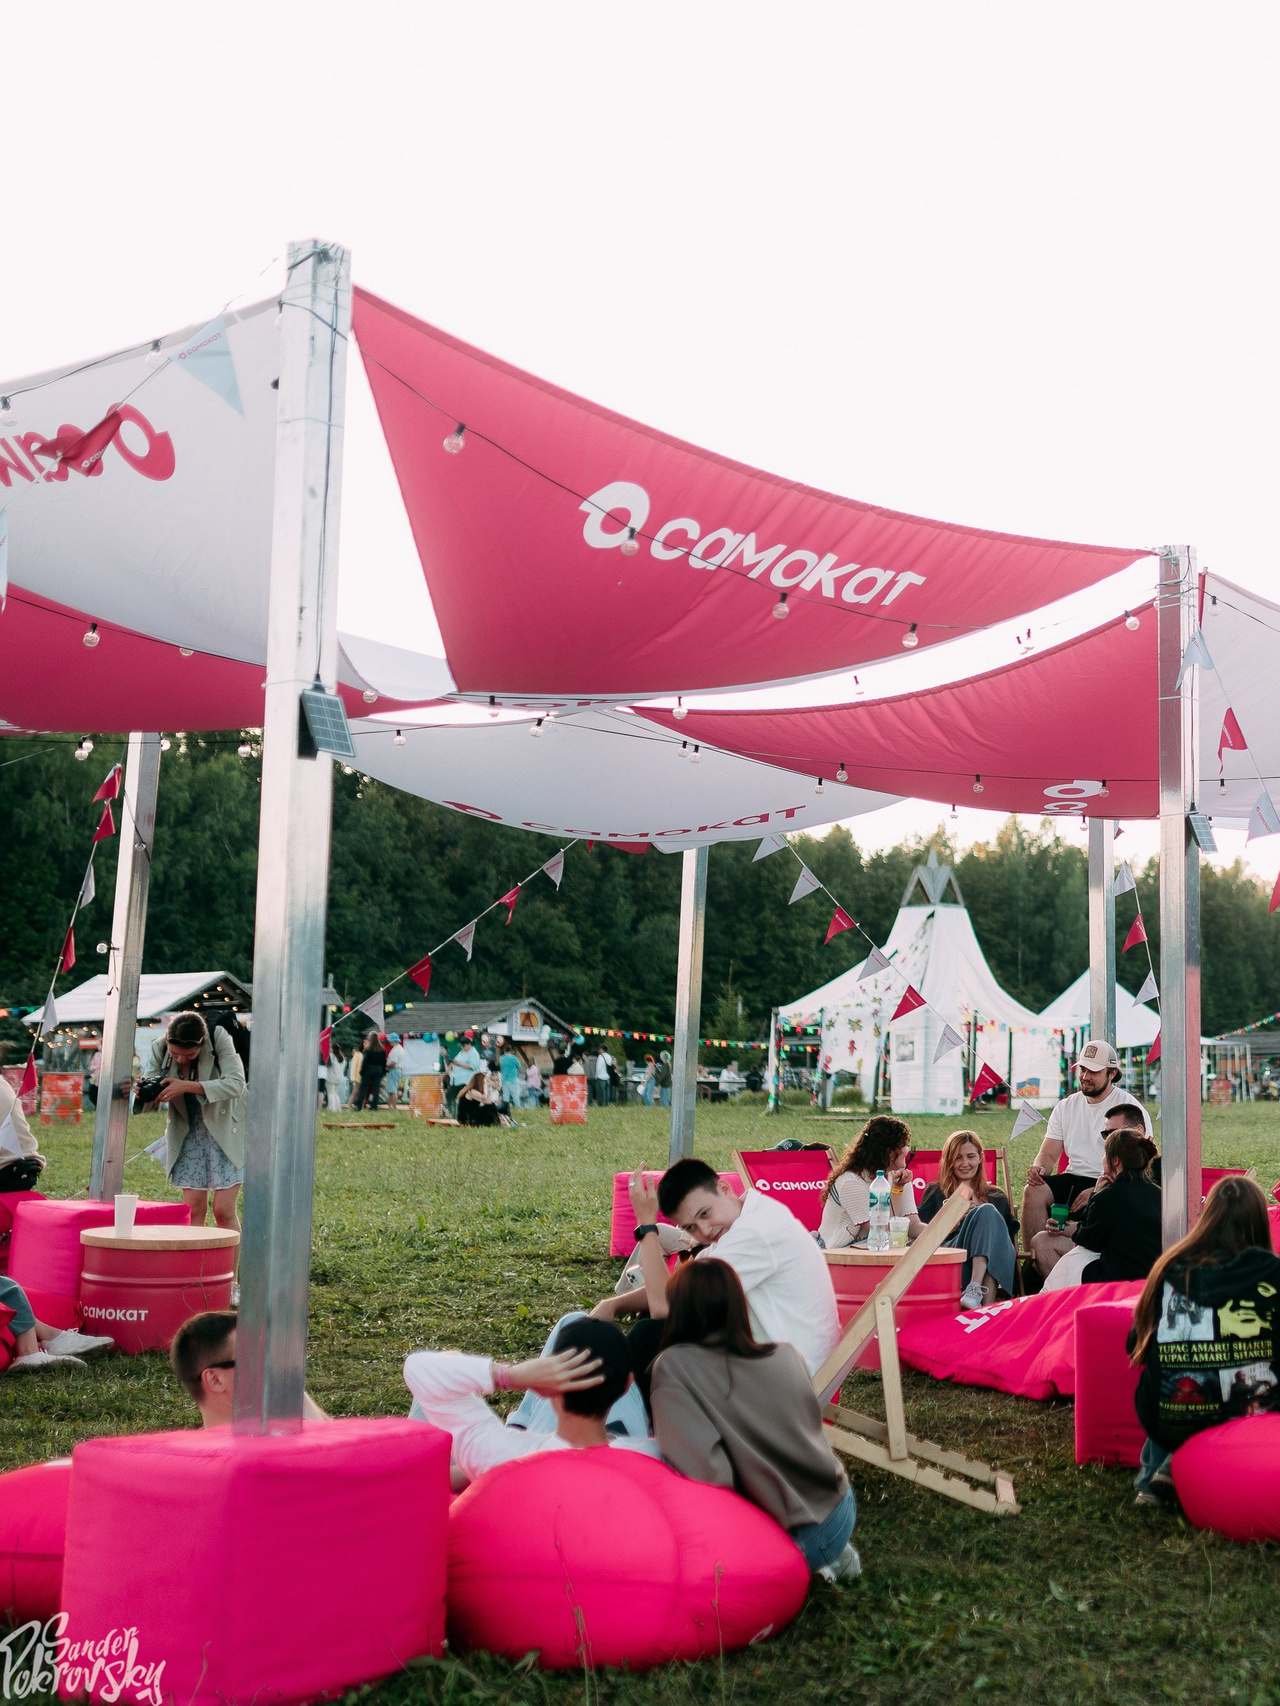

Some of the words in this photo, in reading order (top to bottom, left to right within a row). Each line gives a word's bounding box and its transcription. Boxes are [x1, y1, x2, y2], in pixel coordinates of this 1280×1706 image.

[650, 517, 927, 606] самокат
[521, 804, 806, 838] самокат
[772, 1178, 829, 1191] самока
[82, 1305, 149, 1322] самокат
[1159, 1343, 1189, 1354] TUPAC
[1191, 1342, 1230, 1352] AMARU
[1232, 1340, 1273, 1351] SHAKUR
[1159, 1353, 1190, 1363] TUPAC
[1192, 1352, 1231, 1362] AMARU
[1233, 1349, 1273, 1361] SHAKUR
